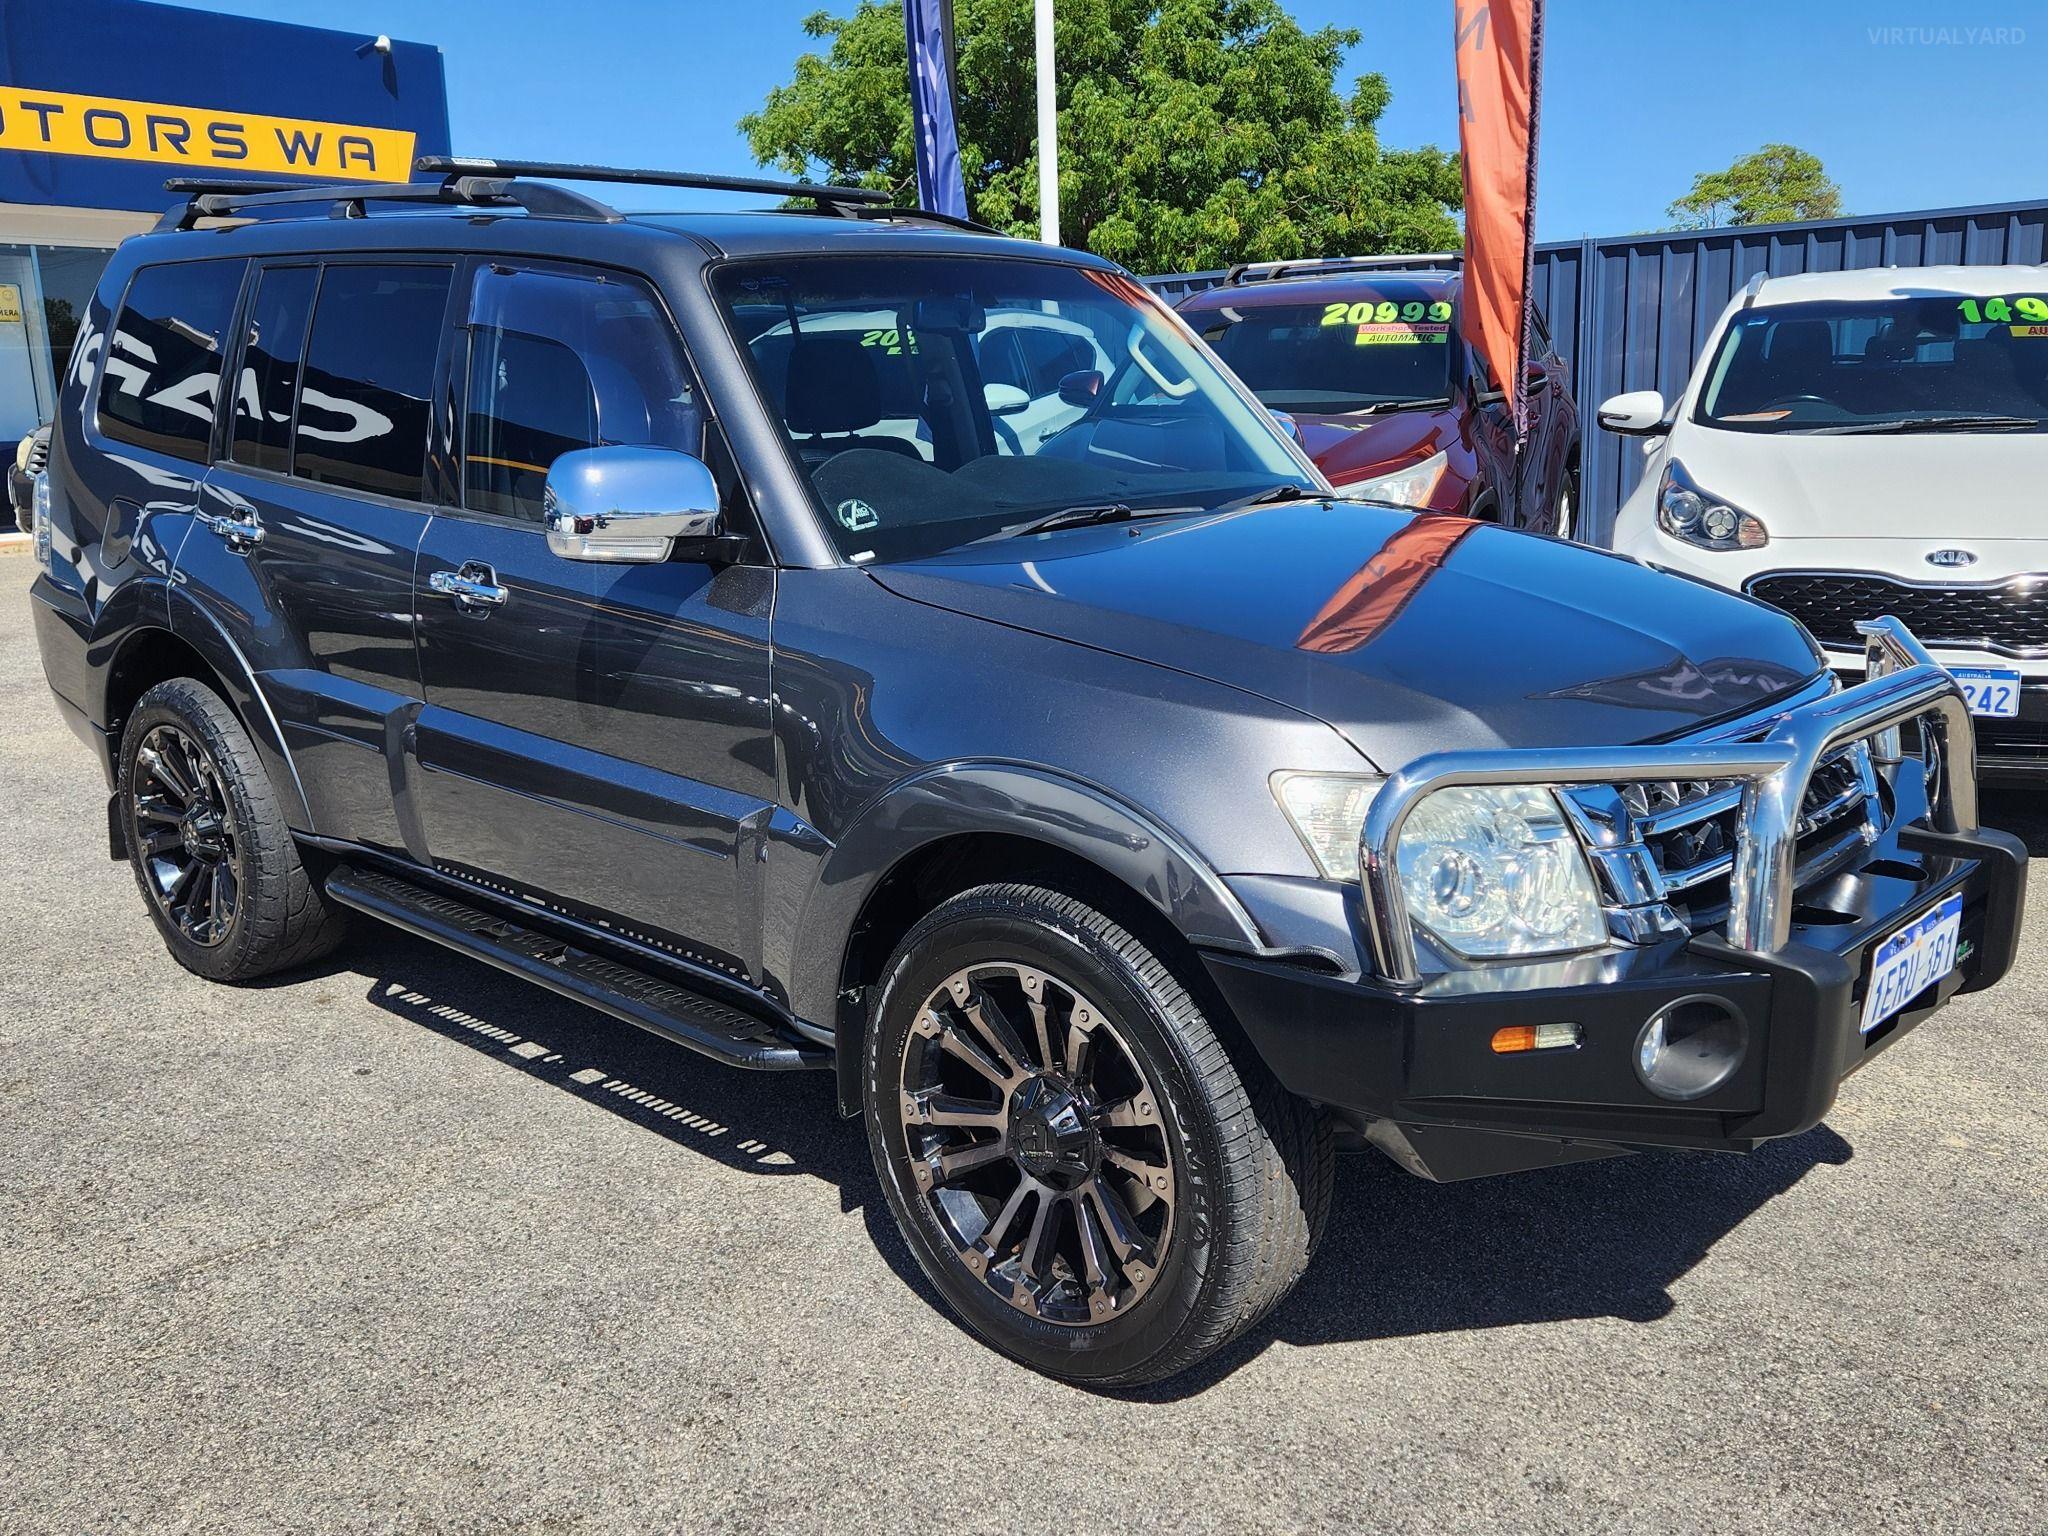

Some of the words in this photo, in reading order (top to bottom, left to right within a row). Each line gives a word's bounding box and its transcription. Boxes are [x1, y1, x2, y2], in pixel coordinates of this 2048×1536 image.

[0, 101, 248, 160] TORS
[275, 128, 376, 172] WA
[1321, 302, 1452, 325] 20999
[1361, 324, 1410, 333] Workshop
[1368, 333, 1437, 342] AUTOMATIC
[1933, 551, 1970, 563] KIA
